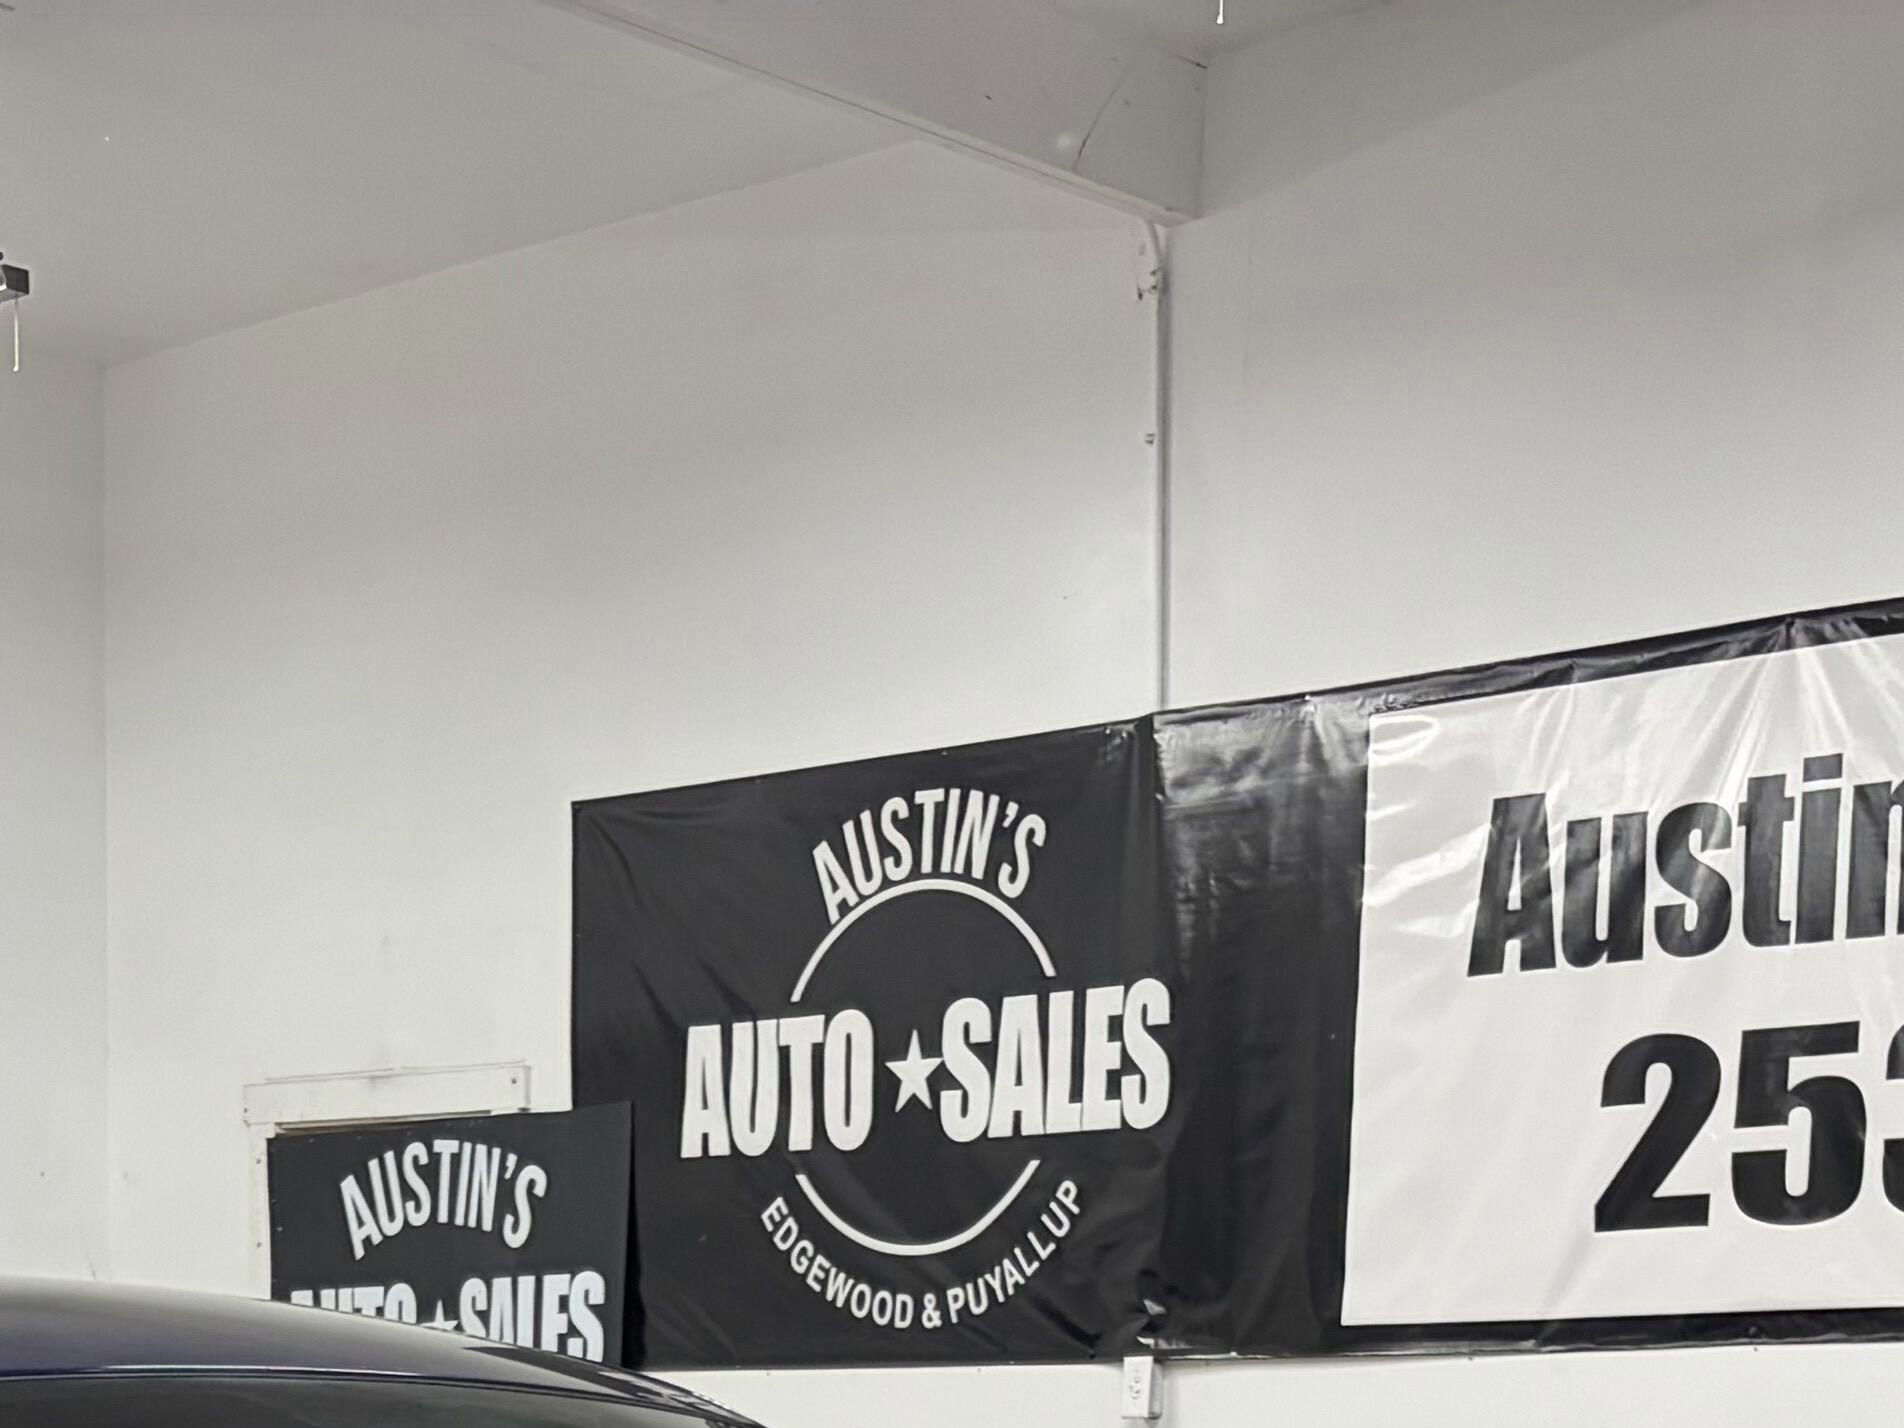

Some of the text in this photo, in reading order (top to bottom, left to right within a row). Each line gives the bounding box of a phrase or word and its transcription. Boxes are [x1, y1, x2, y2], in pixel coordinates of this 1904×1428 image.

[812, 788, 1047, 925] AUSTIN'S
[681, 978, 1171, 1158] AUTO SALES
[339, 1139, 547, 1260] AUSTIN'S
[760, 1179, 1080, 1329] EDGEWOOD & PUYALLUP
